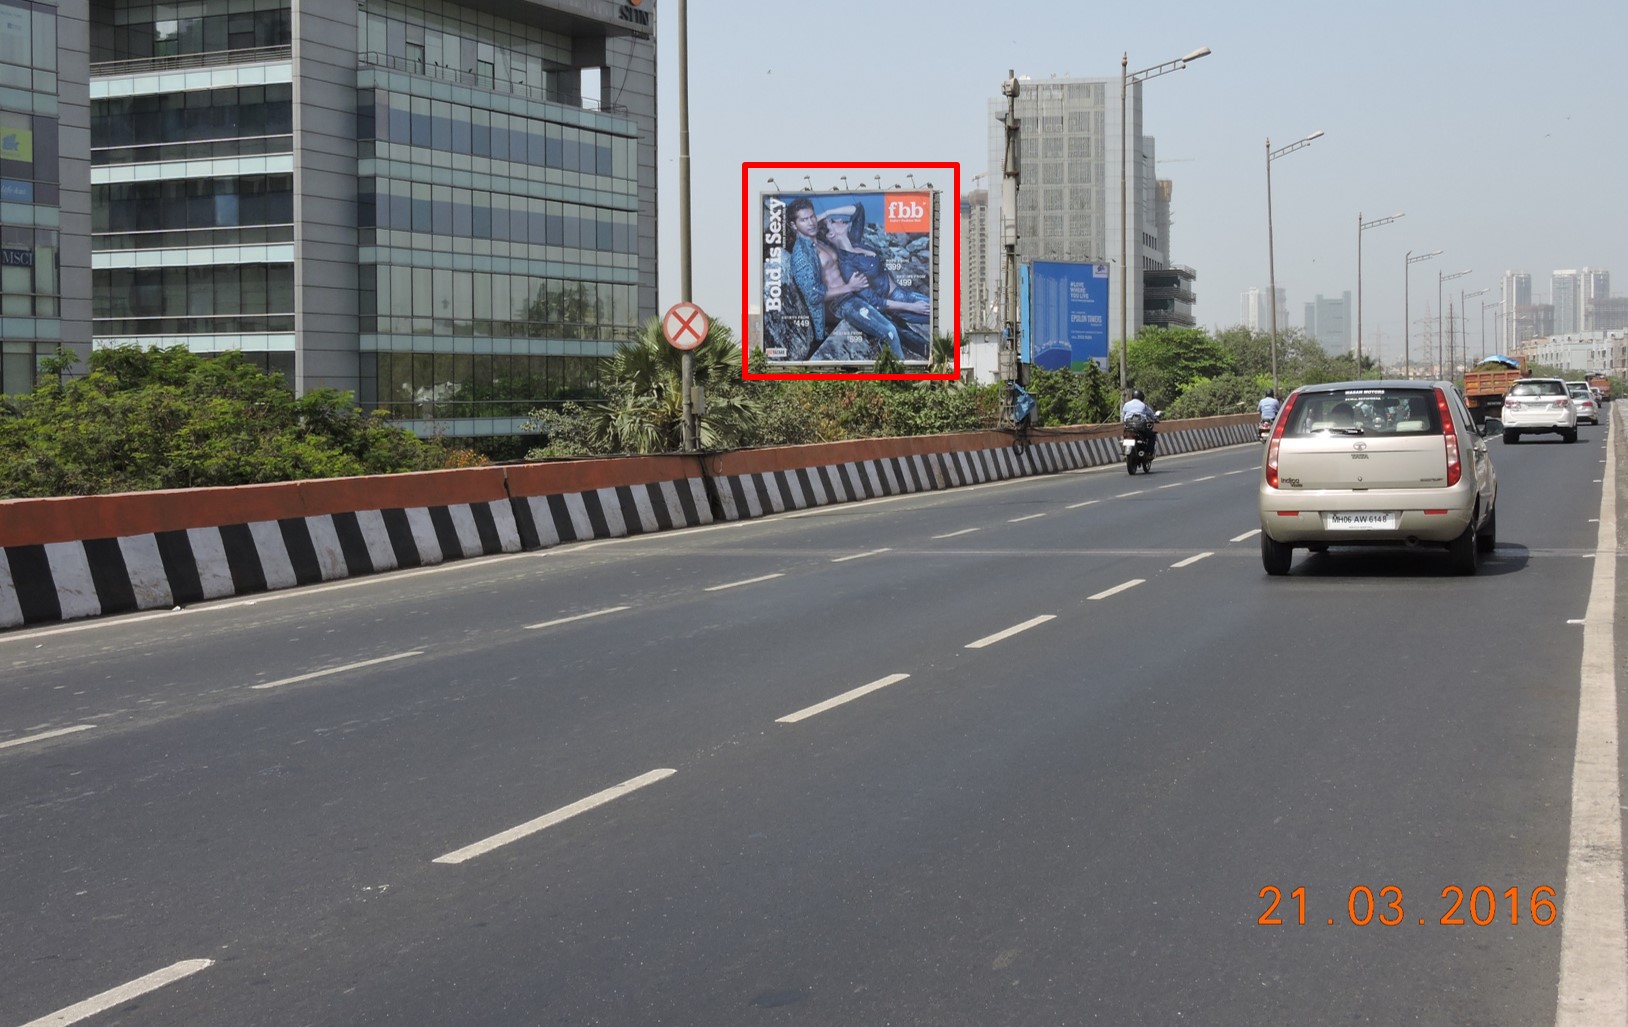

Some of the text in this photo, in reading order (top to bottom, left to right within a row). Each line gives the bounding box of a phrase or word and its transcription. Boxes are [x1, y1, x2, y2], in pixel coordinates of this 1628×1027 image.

[888, 201, 924, 218] fbb
[3, 251, 33, 265] MSCI
[765, 197, 786, 313] Bold is Sexy
[1332, 515, 1387, 524] MH06 AW 6148
